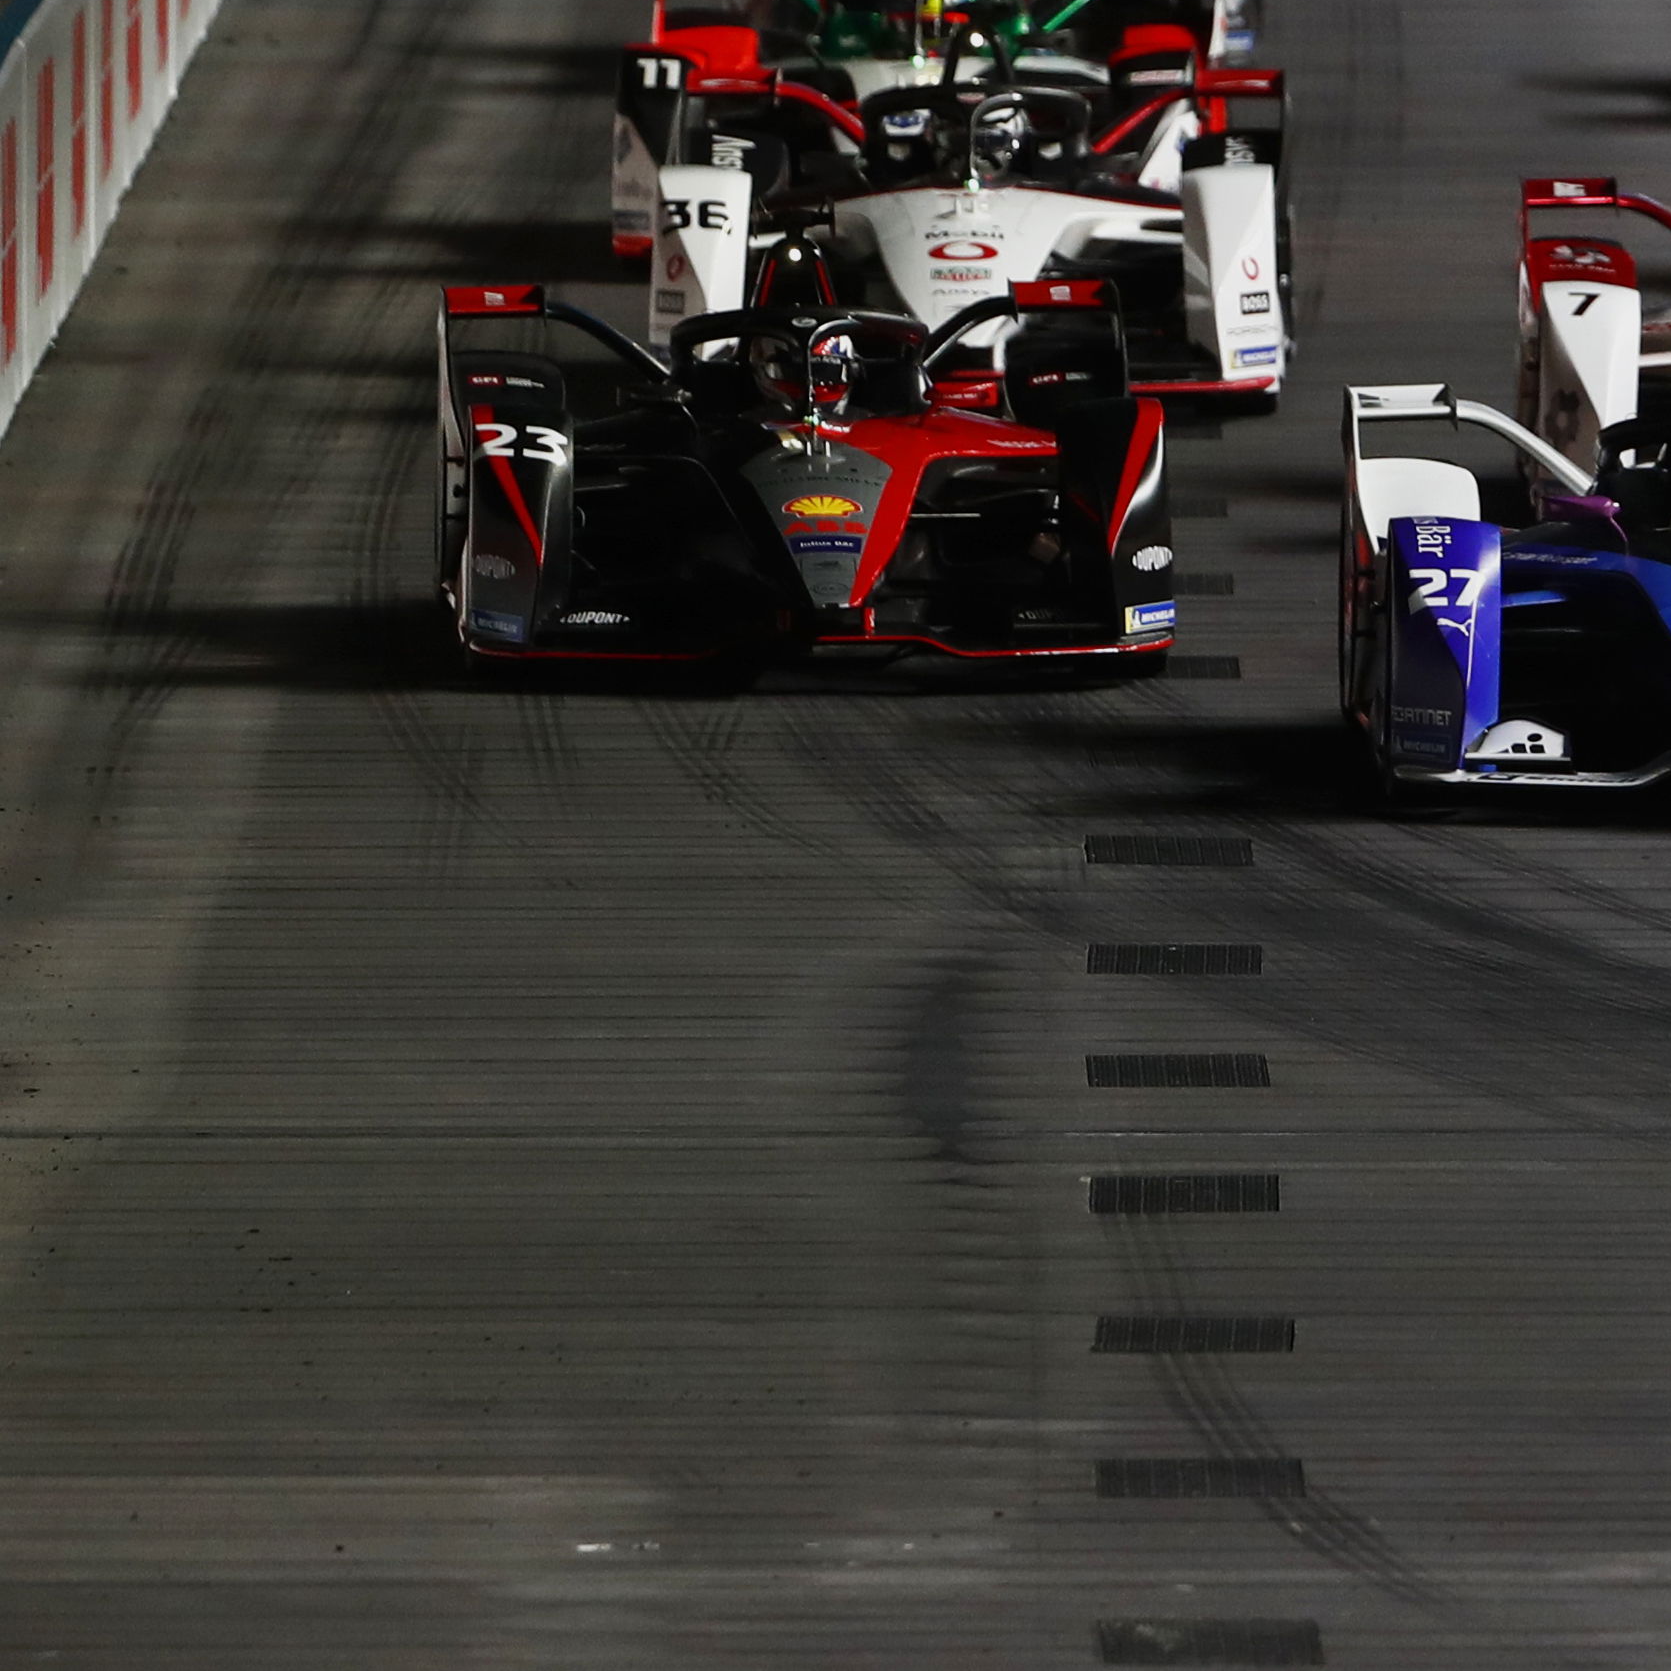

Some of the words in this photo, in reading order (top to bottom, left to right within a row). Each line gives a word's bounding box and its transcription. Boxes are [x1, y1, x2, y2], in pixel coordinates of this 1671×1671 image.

[637, 58, 682, 90] 11
[662, 199, 731, 234] 36
[1242, 294, 1269, 313] BOSS
[1567, 291, 1602, 317] 7
[474, 423, 569, 467] 23
[784, 520, 868, 536] ABB
[1416, 522, 1452, 559] Bär
[1409, 568, 1487, 616] 27
[567, 610, 623, 626] DUPONT
